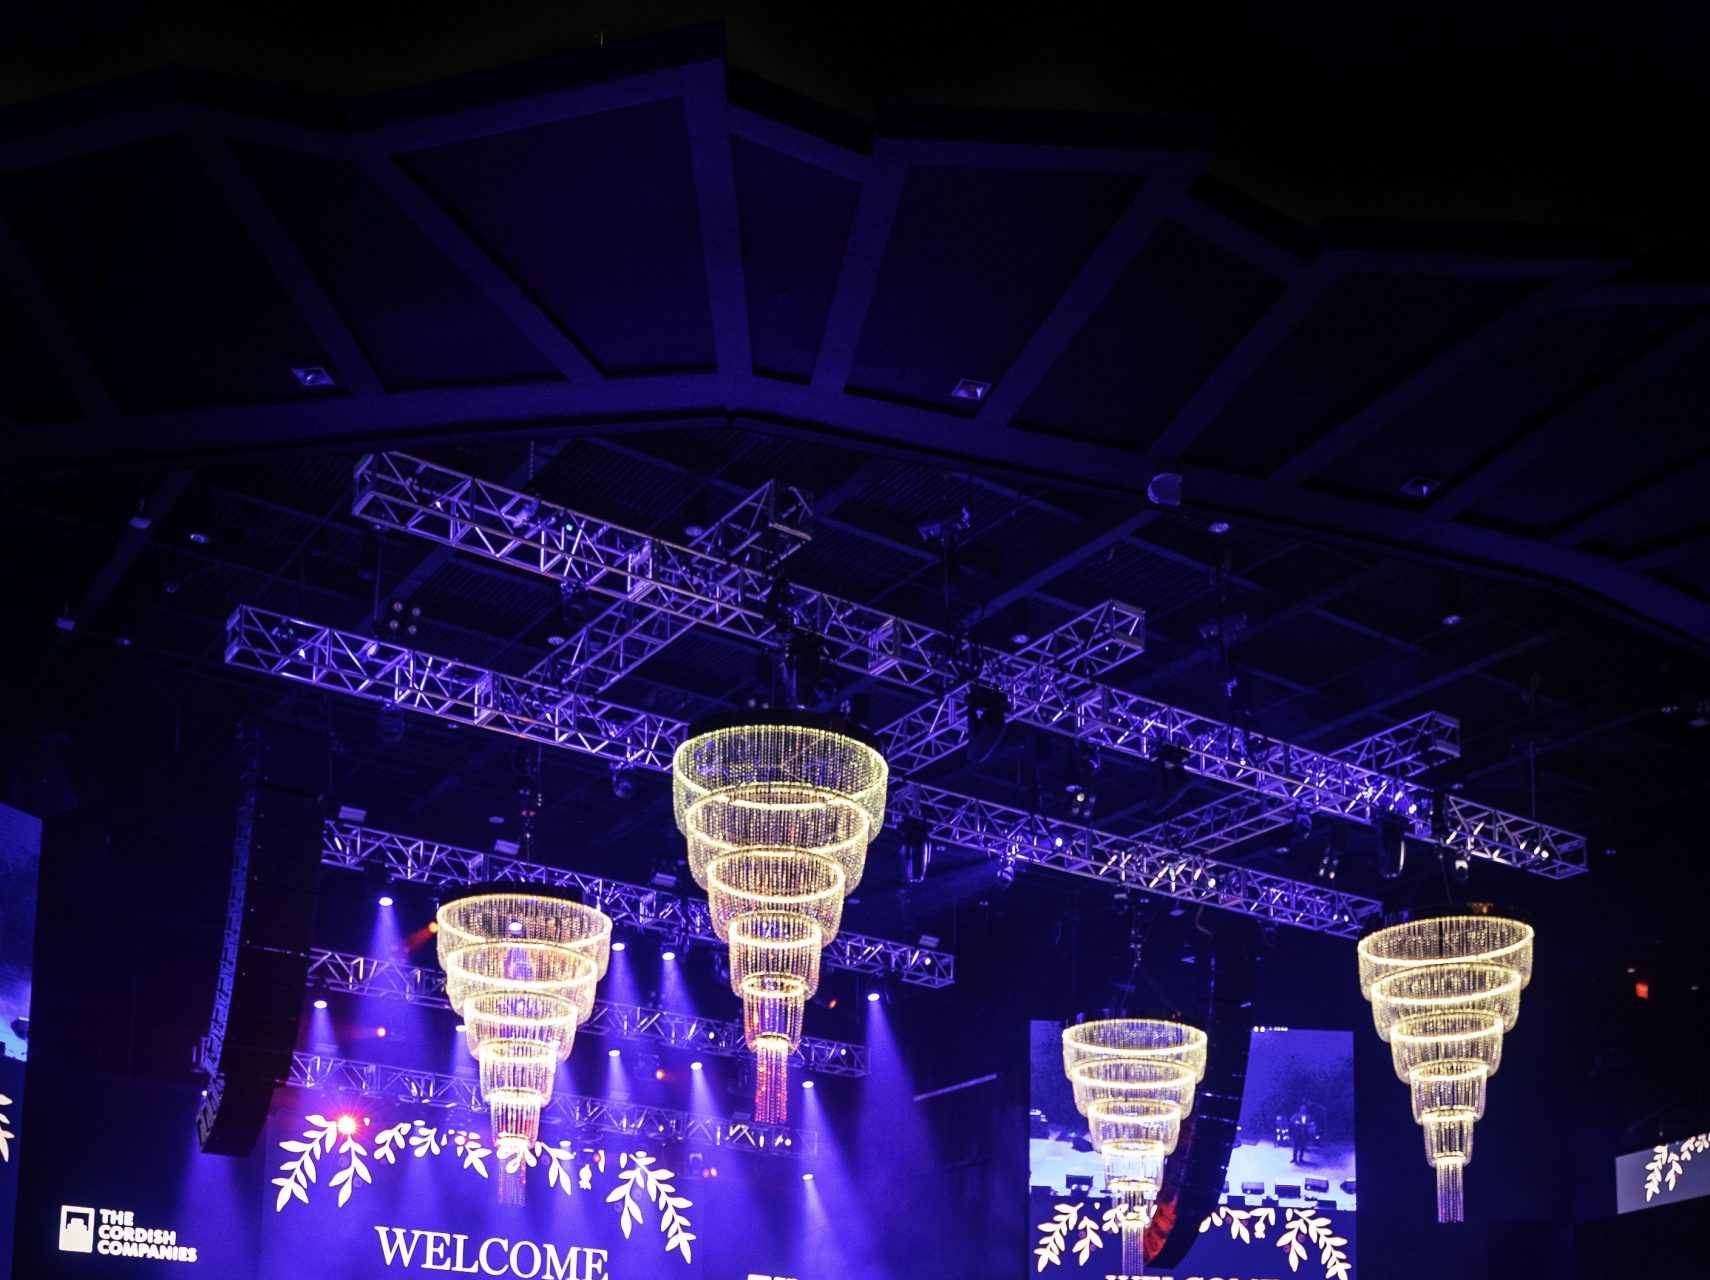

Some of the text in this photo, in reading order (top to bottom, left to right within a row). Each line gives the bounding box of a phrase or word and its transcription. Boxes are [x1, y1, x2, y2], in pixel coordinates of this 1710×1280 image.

[99, 1208, 134, 1226] THE
[98, 1225, 177, 1246] CORDISH
[97, 1240, 198, 1262] COMPANIES
